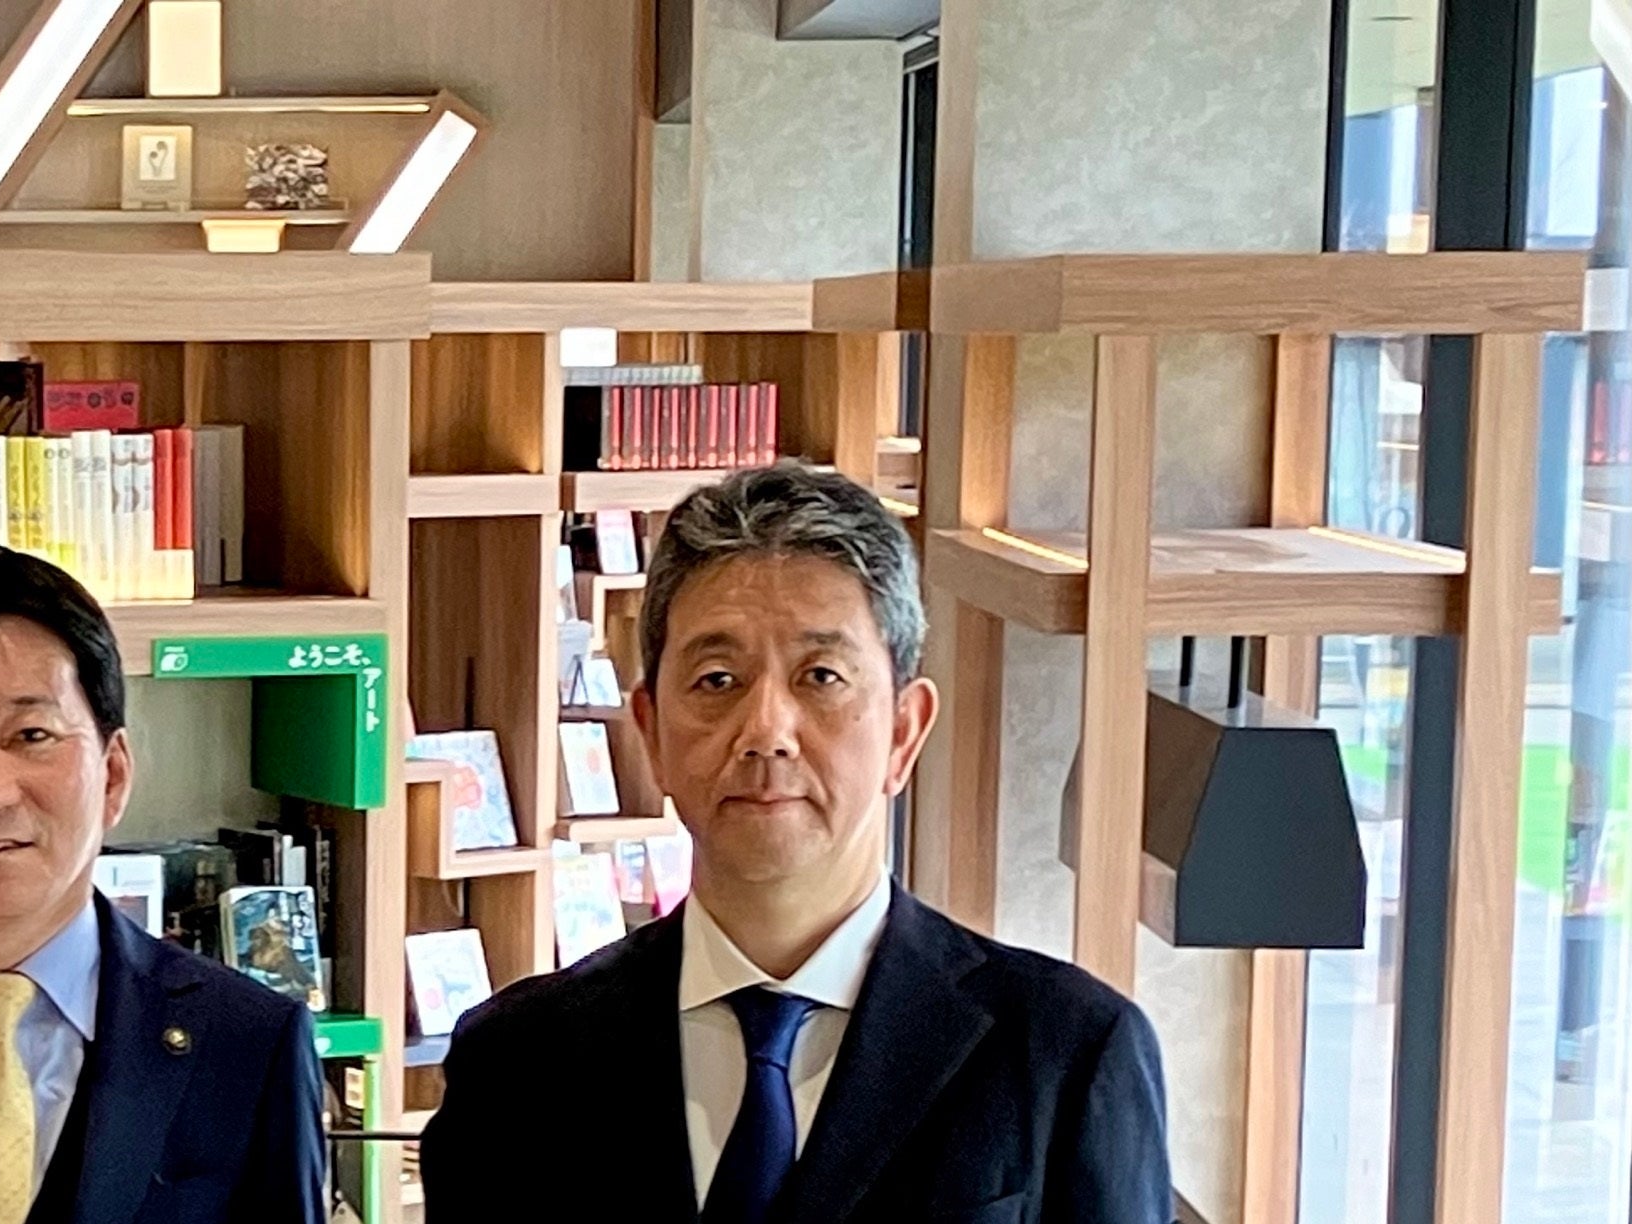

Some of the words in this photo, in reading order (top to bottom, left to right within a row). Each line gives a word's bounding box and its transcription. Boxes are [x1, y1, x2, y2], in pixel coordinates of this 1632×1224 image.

[288, 643, 371, 668] ようこそ、
[361, 667, 383, 733] アート
